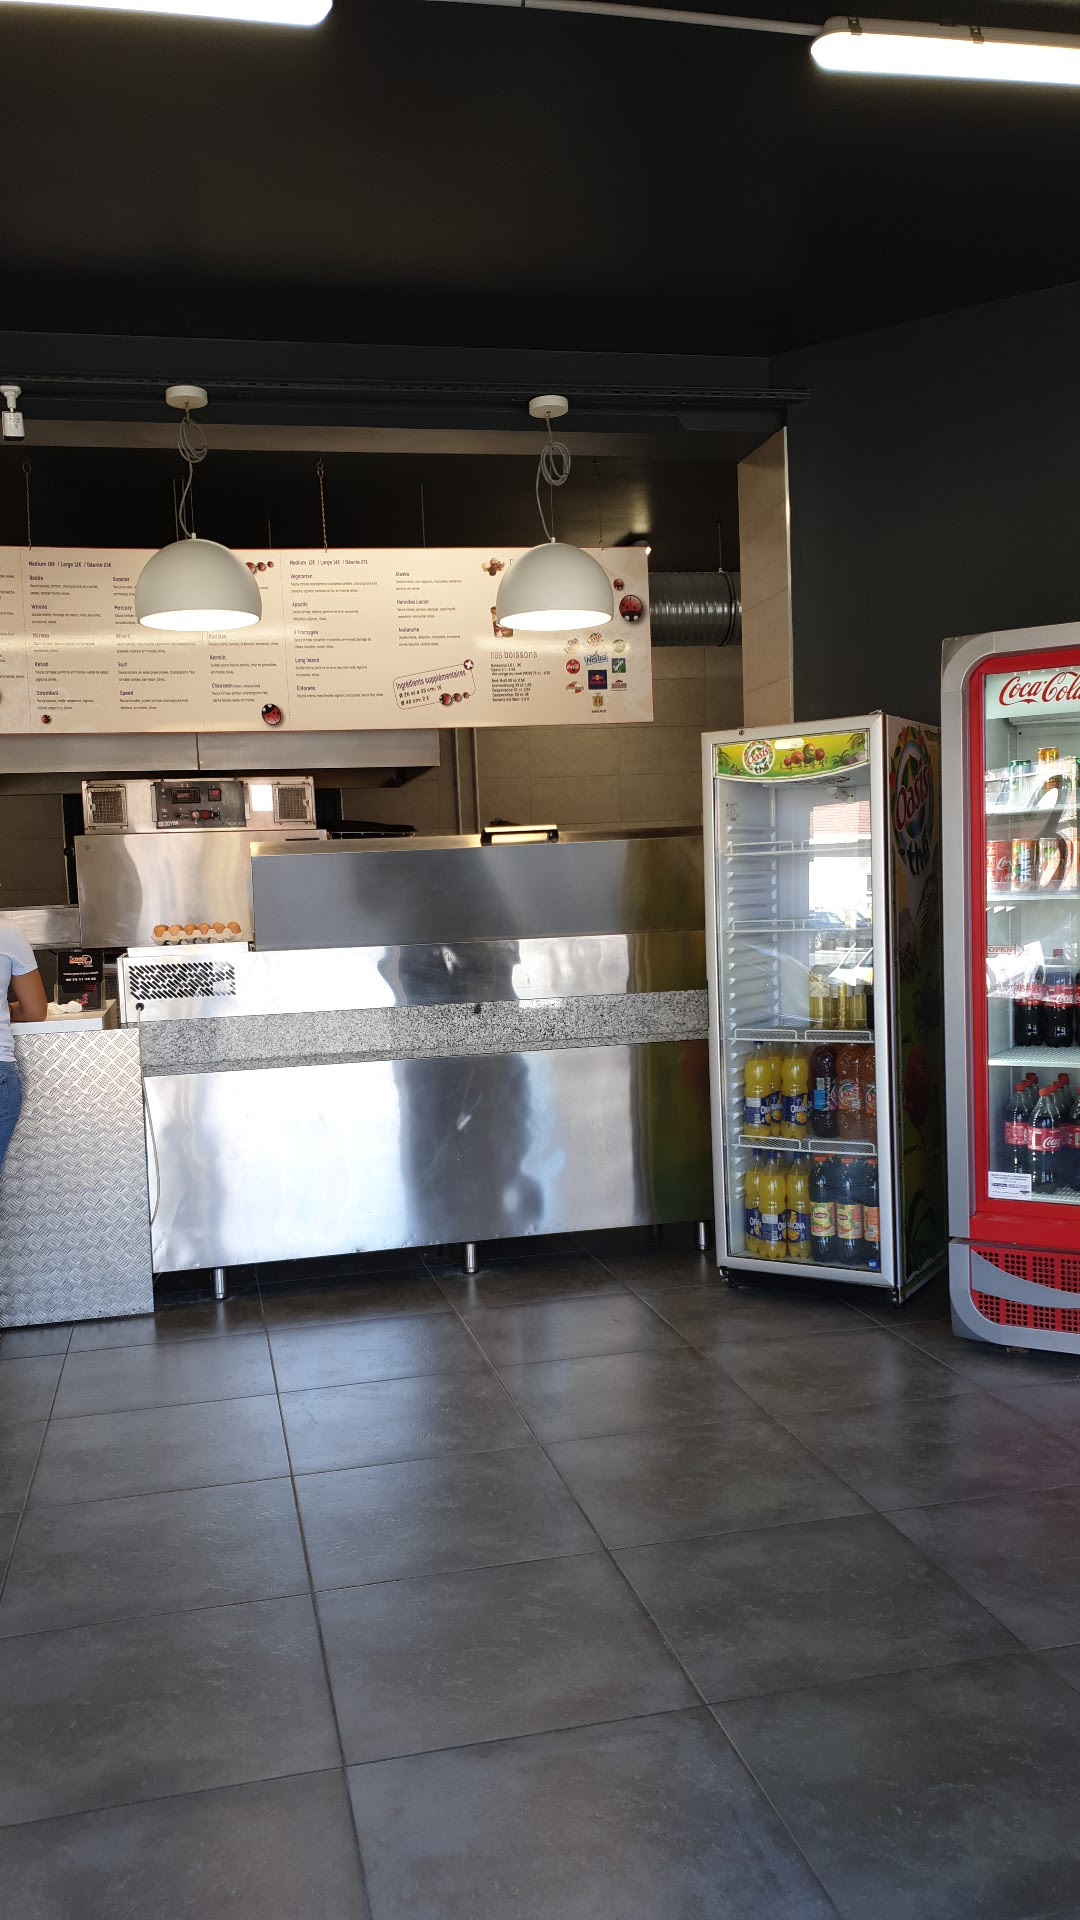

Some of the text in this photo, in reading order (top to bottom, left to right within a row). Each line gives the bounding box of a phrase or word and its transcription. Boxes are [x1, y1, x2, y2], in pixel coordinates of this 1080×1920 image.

[504, 650, 538, 659] boissons
[998, 671, 1080, 707] Coca-Cola
[747, 747, 769, 765] Oasis
[754, 763, 770, 774] thé
[895, 757, 928, 832] Oasis
